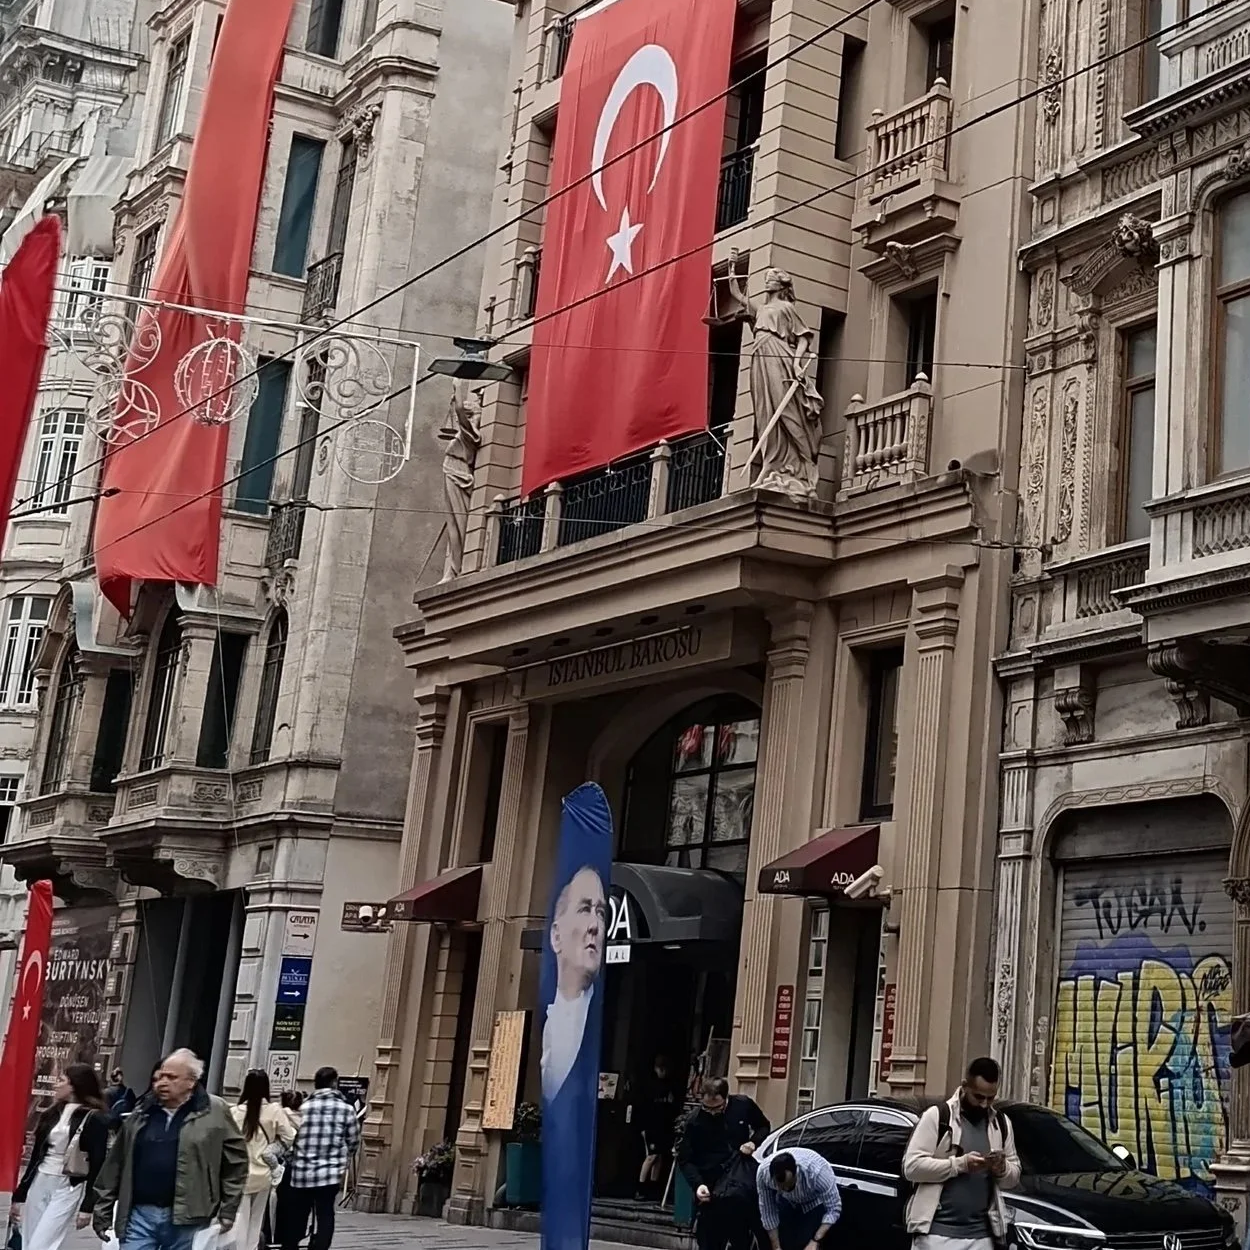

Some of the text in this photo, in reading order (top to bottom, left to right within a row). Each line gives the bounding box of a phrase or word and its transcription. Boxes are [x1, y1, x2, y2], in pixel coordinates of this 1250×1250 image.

[630, 628, 702, 669] BAROSU
[773, 870, 790, 884] ADA
[831, 872, 855, 885] ADA
[54, 949, 80, 961] EDWARD
